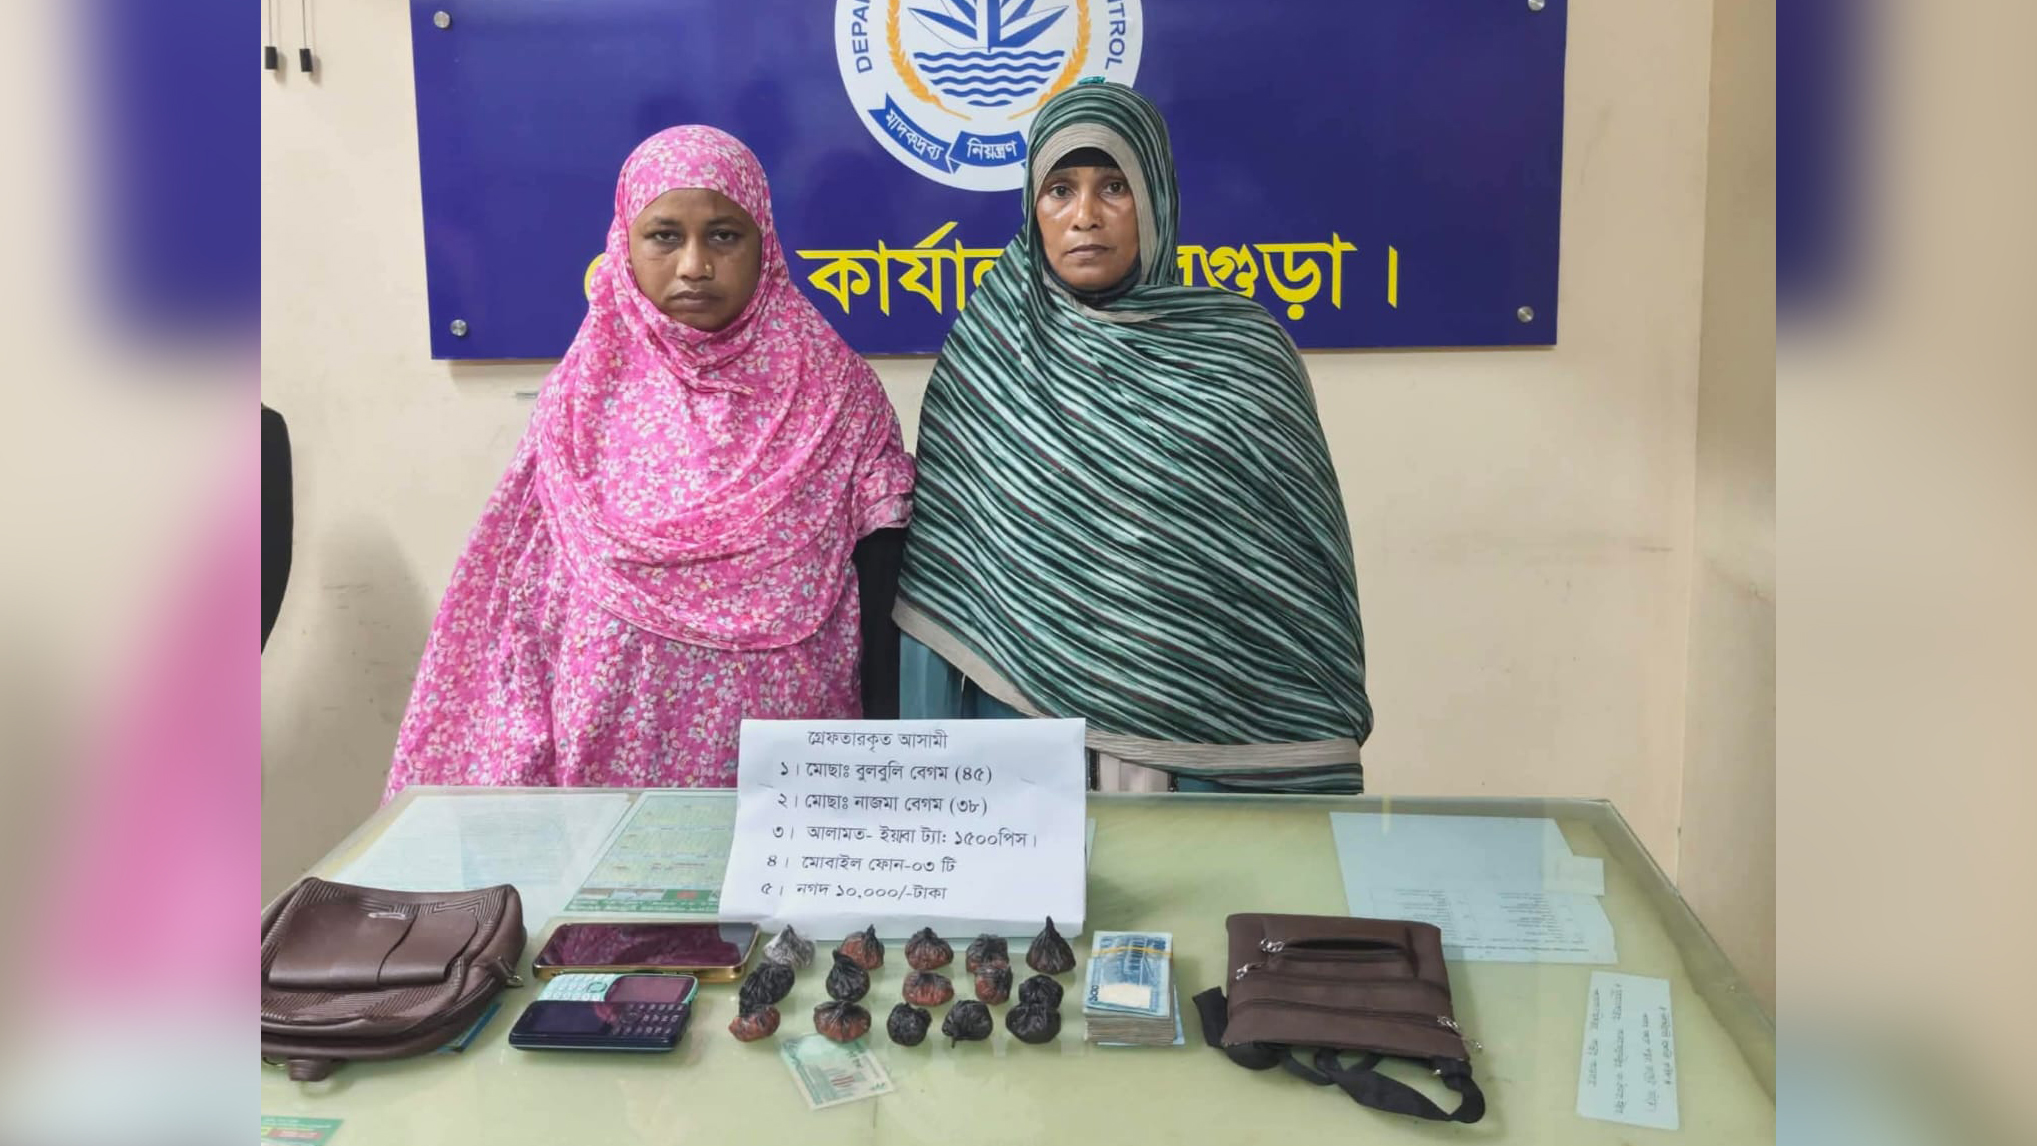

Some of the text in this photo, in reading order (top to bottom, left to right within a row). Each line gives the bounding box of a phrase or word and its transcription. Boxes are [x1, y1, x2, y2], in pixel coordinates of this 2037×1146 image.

[851, 0, 873, 74] DEPA
[1105, 0, 1126, 70] TROL
[796, 221, 1006, 316] কার্যা
[807, 729, 949, 753] গ্রেফতারকৃত আসামী
[855, 760, 905, 783] বুলবুলি
[910, 765, 949, 781] বেগম
[955, 765, 993, 786] (৪৫)
[853, 795, 900, 812] নাজমা
[904, 797, 944, 812] বেগম
[949, 796, 988, 815] (৩৮)
[802, 854, 864, 870] মোবাইল
[941, 855, 958, 873] টি
[796, 883, 831, 896] নগদ
